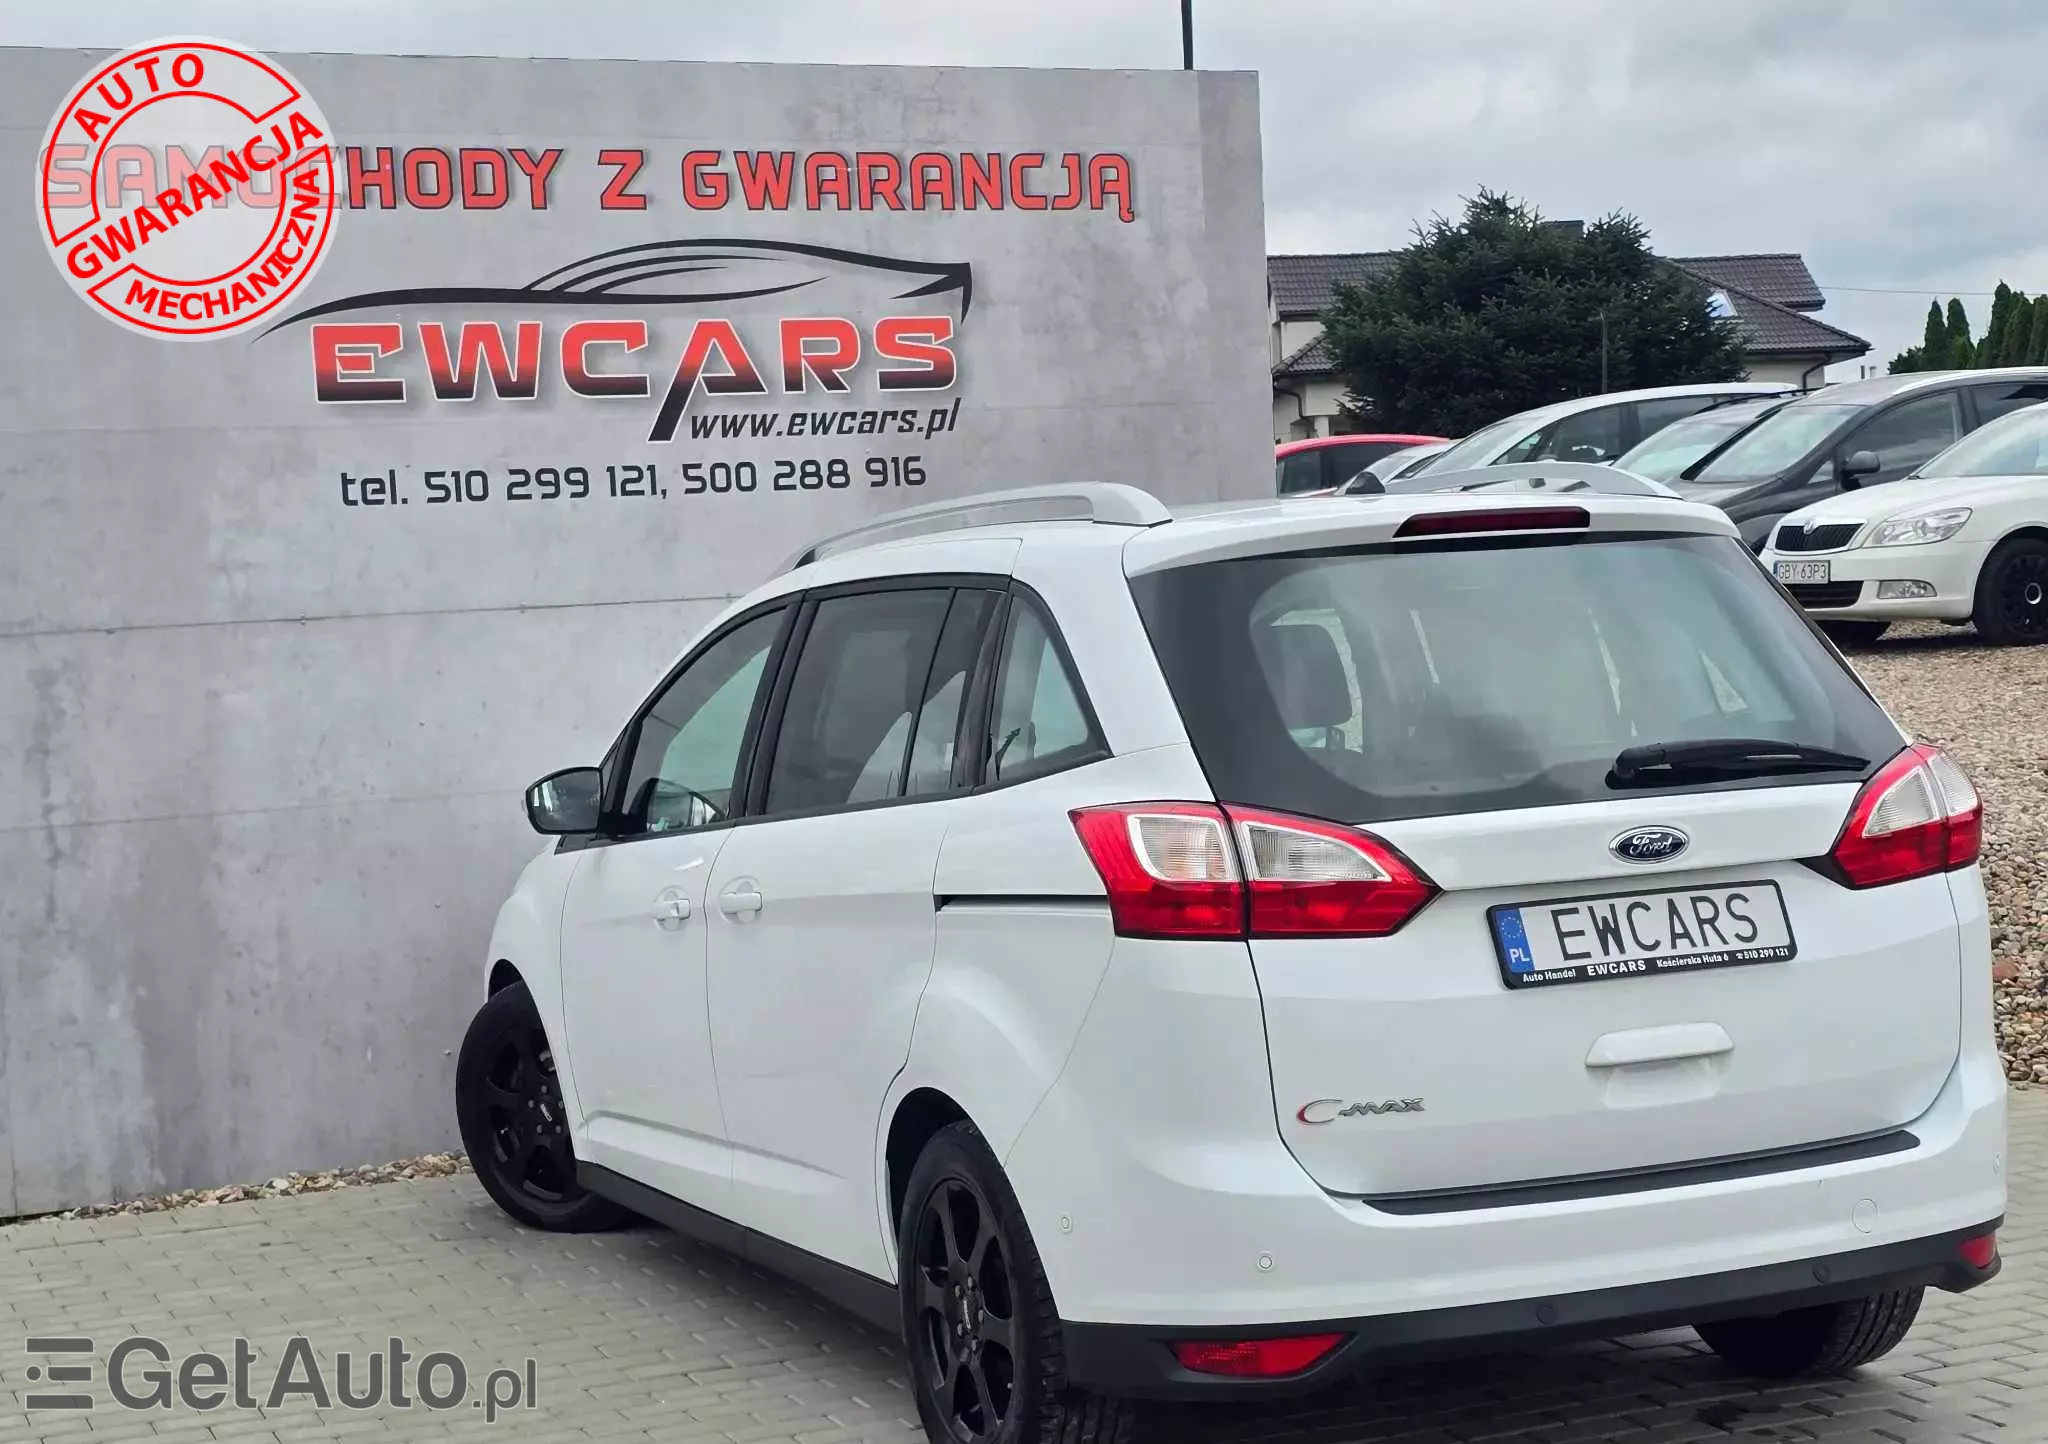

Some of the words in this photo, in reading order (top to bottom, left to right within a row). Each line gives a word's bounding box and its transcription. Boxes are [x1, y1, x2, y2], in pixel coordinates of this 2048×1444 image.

[39, 144, 564, 210] SAMOCHODY
[597, 149, 647, 210] Z
[681, 149, 1135, 223] GWARANCJĄ
[311, 316, 957, 442] EWCARS
[689, 397, 962, 440] www.ewcars.pl
[340, 469, 409, 506] tel.
[423, 469, 490, 504] 510
[506, 466, 590, 501] 299
[605, 464, 668, 500] 121,
[681, 460, 758, 495] 500
[772, 458, 851, 491] 288
[864, 455, 927, 488] 916
[1778, 563, 1799, 580] GBY
[1629, 833, 1673, 855] Ford
[1550, 892, 1758, 962] EWCARS
[1509, 948, 1531, 964] PL
[1522, 973, 1544, 983] Auto
[1544, 968, 1577, 980] Handel
[1586, 959, 1647, 977] EWCARS
[1759, 948, 1774, 959] 299
[1775, 946, 1789, 957] 121
